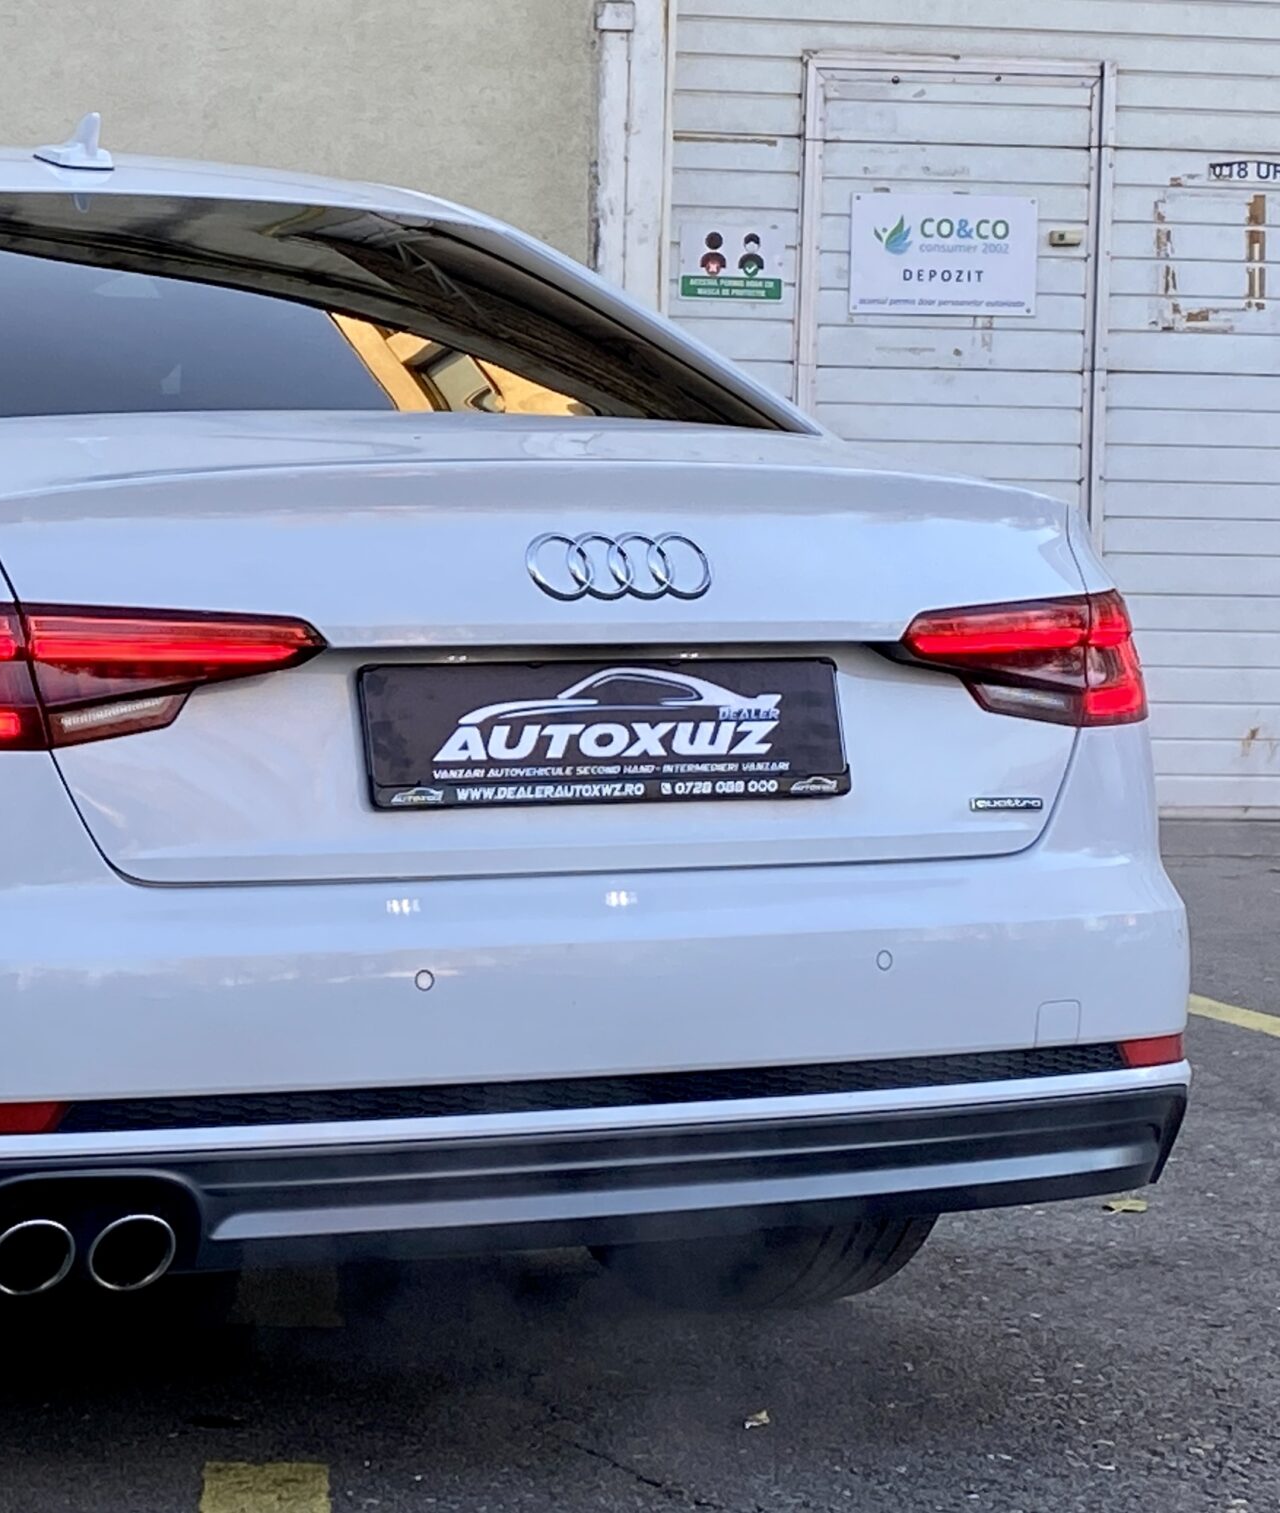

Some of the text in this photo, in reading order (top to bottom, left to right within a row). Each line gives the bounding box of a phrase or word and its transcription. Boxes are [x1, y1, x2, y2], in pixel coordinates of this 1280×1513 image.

[920, 217, 1010, 240] CO&CO
[919, 243, 1010, 255] consumer 2002
[902, 268, 985, 283] DEPOZIT
[719, 708, 780, 720] DEALER
[432, 720, 780, 762] AUTOXWZ
[432, 768, 485, 780] VANZARI
[486, 766, 572, 779] AUTOVEHICULE
[576, 764, 621, 776] SECOND
[623, 764, 655, 775] HAND
[741, 761, 790, 772] VANZARI
[456, 783, 645, 801] WWW.DEALERAUTOXWZ.RO
[974, 798, 1042, 809] quattro
